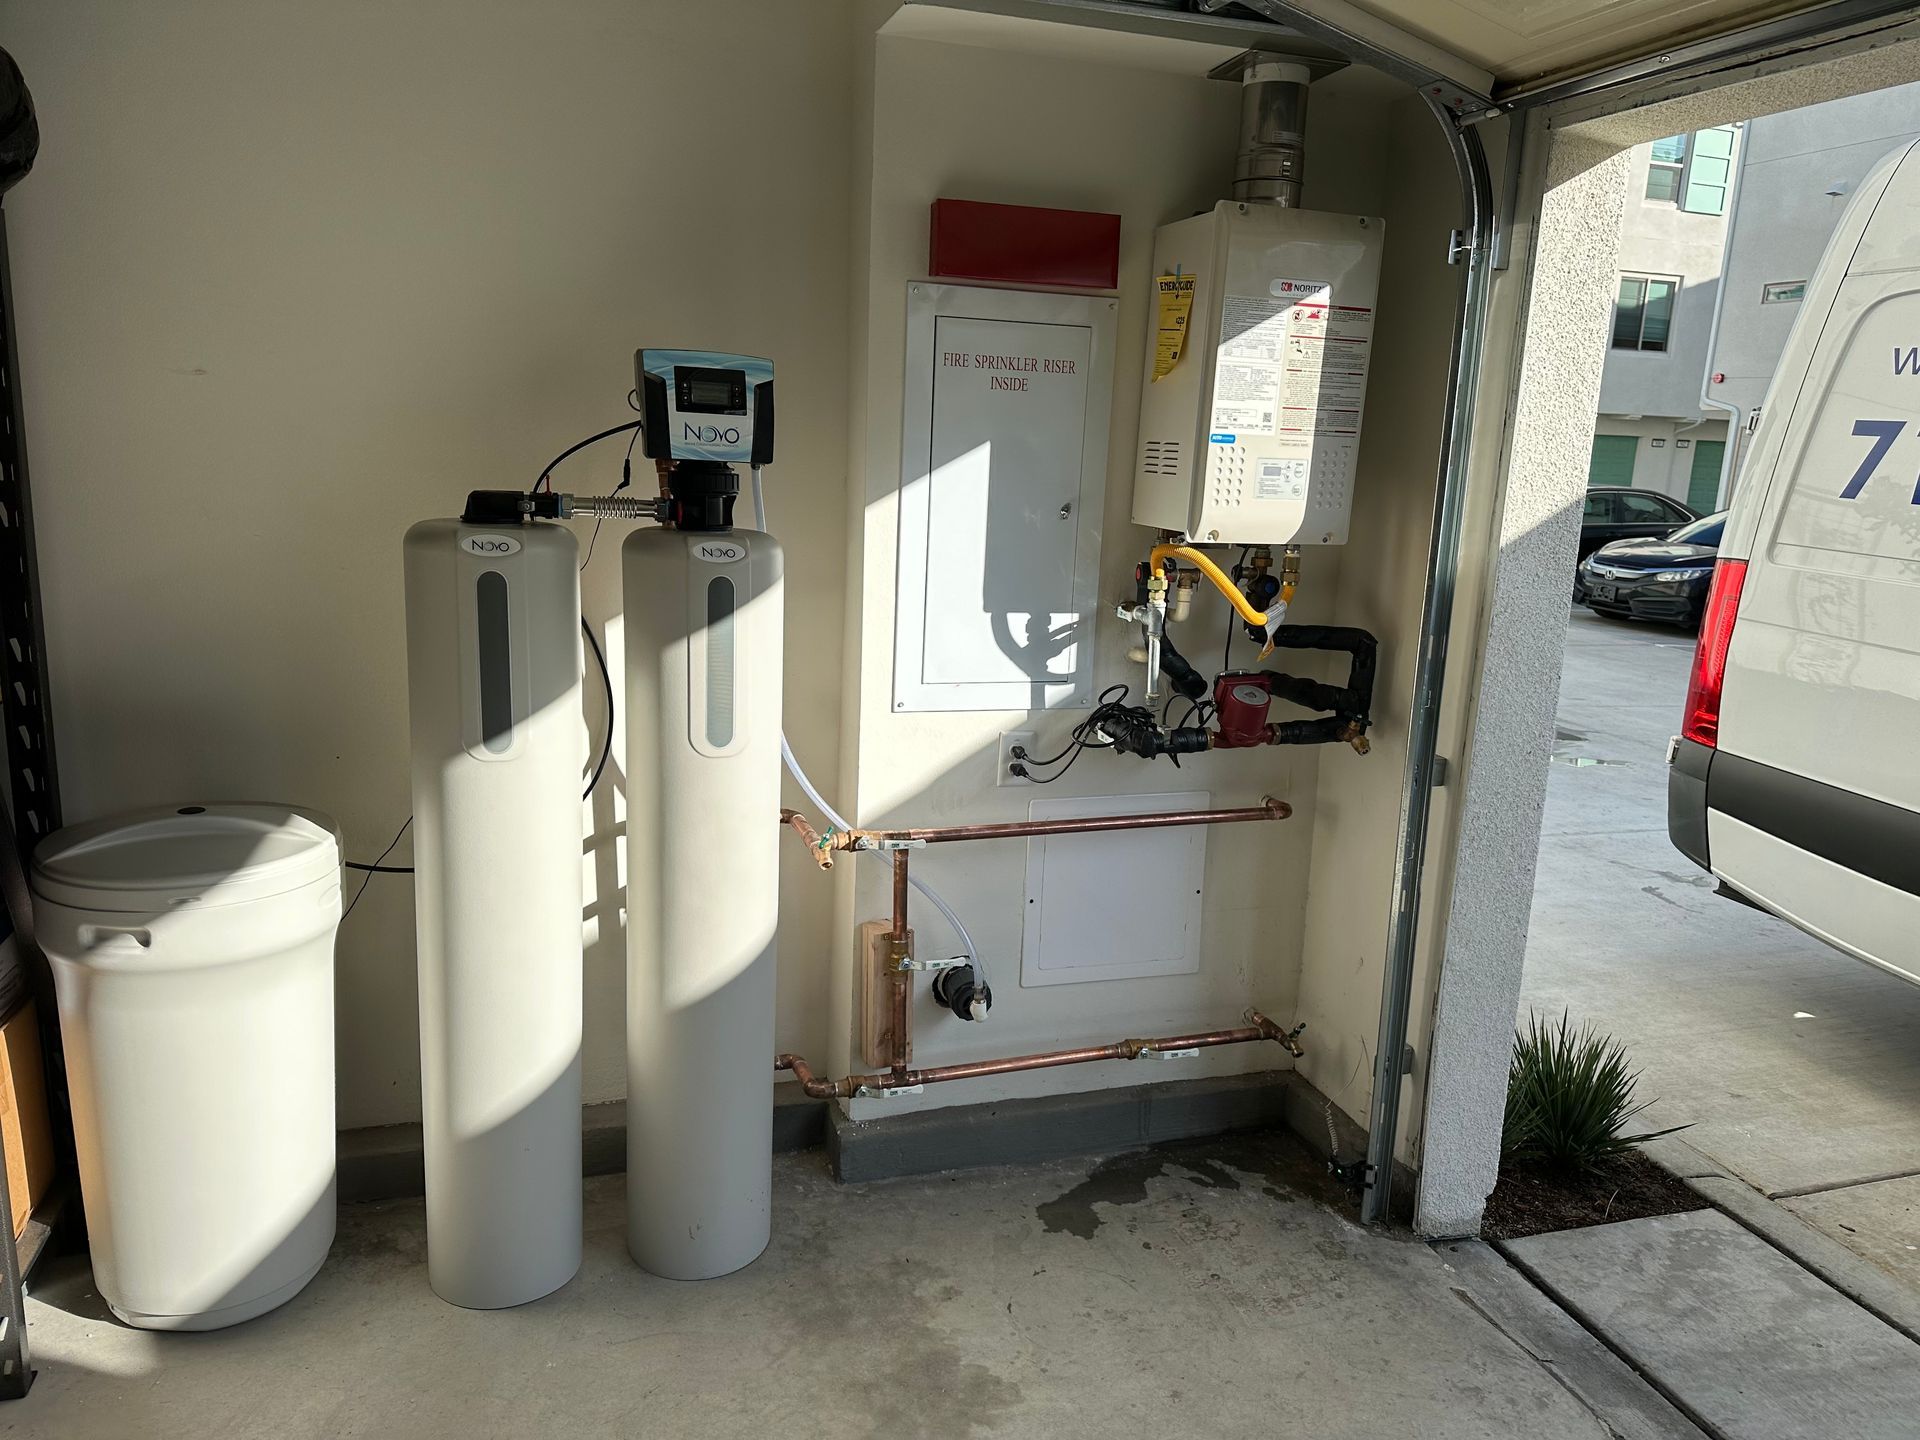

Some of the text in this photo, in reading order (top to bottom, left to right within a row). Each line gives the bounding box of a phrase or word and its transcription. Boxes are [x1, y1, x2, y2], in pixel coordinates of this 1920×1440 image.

[1293, 284, 1322, 293] NORITZ
[943, 352, 1076, 374] FIRE SPRINKLER RISER
[990, 376, 1028, 391] INSIDE
[684, 421, 740, 444] NOVO
[1839, 420, 1920, 506] 7
[472, 538, 510, 552] NOVO
[701, 546, 736, 559] NOVO
